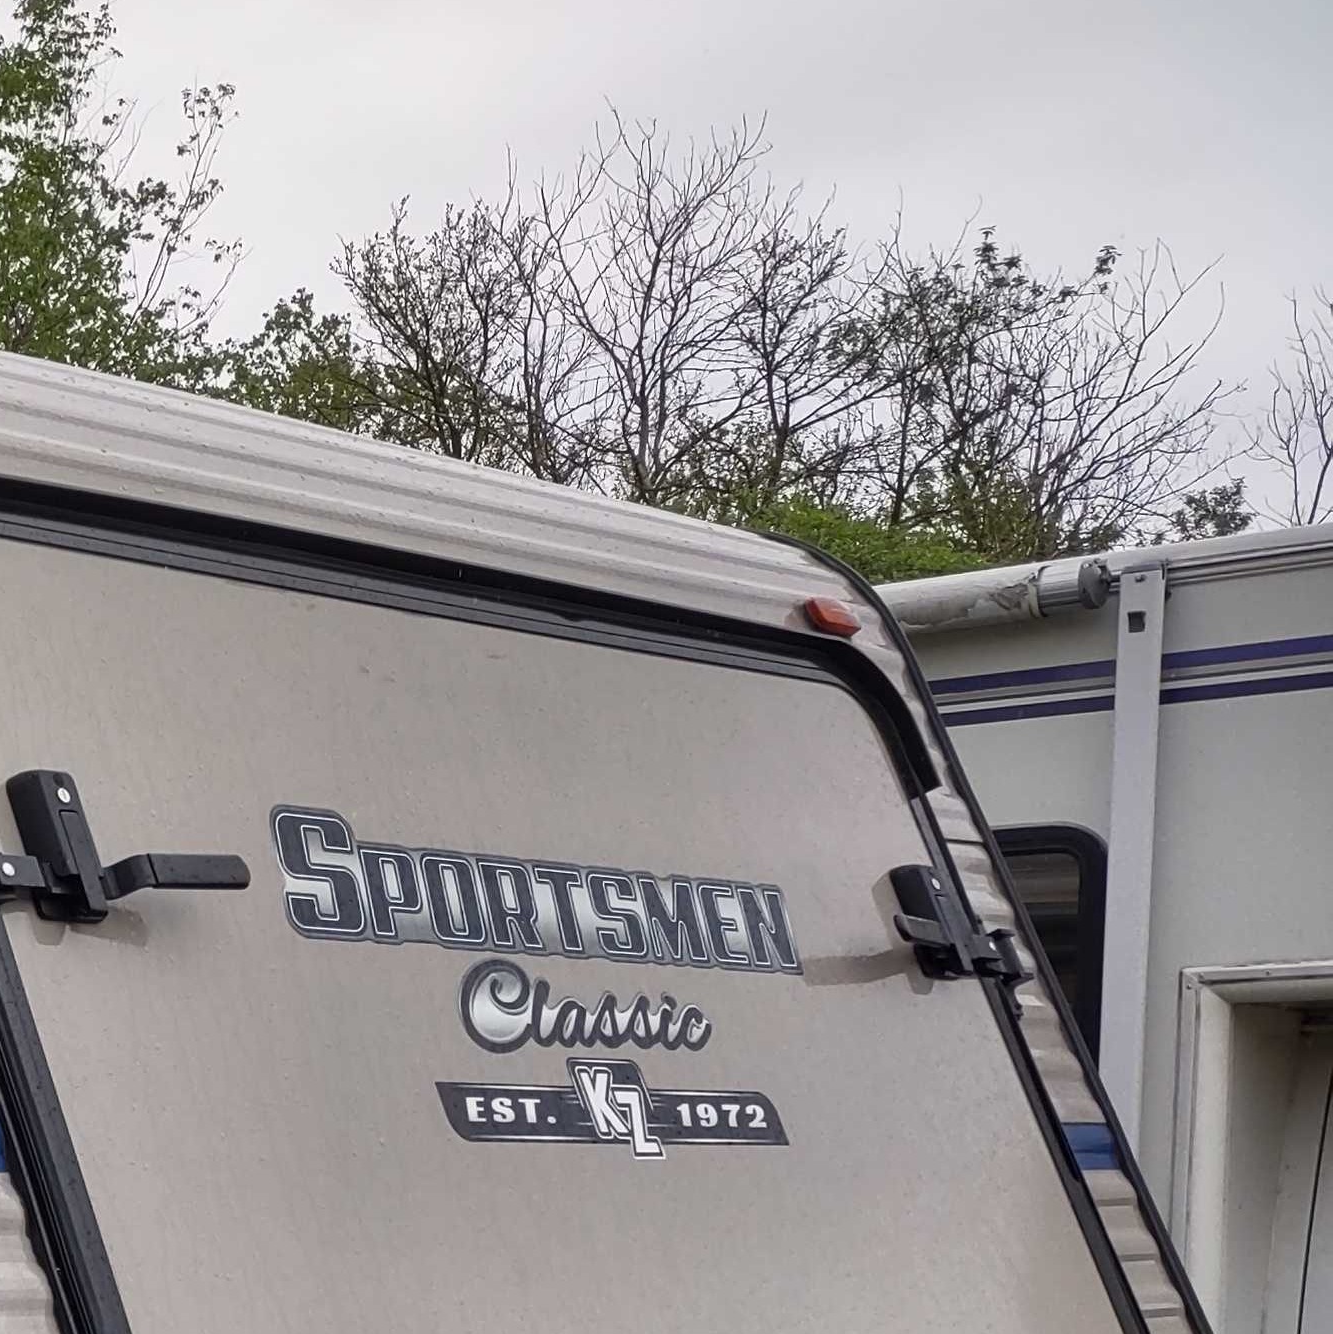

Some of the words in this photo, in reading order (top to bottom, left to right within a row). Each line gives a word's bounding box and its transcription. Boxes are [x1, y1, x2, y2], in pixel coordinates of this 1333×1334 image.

[460, 959, 712, 1052] Classic
[465, 1095, 558, 1125] EST.
[573, 1064, 664, 1158] KZ
[676, 1103, 769, 1130] 1972
